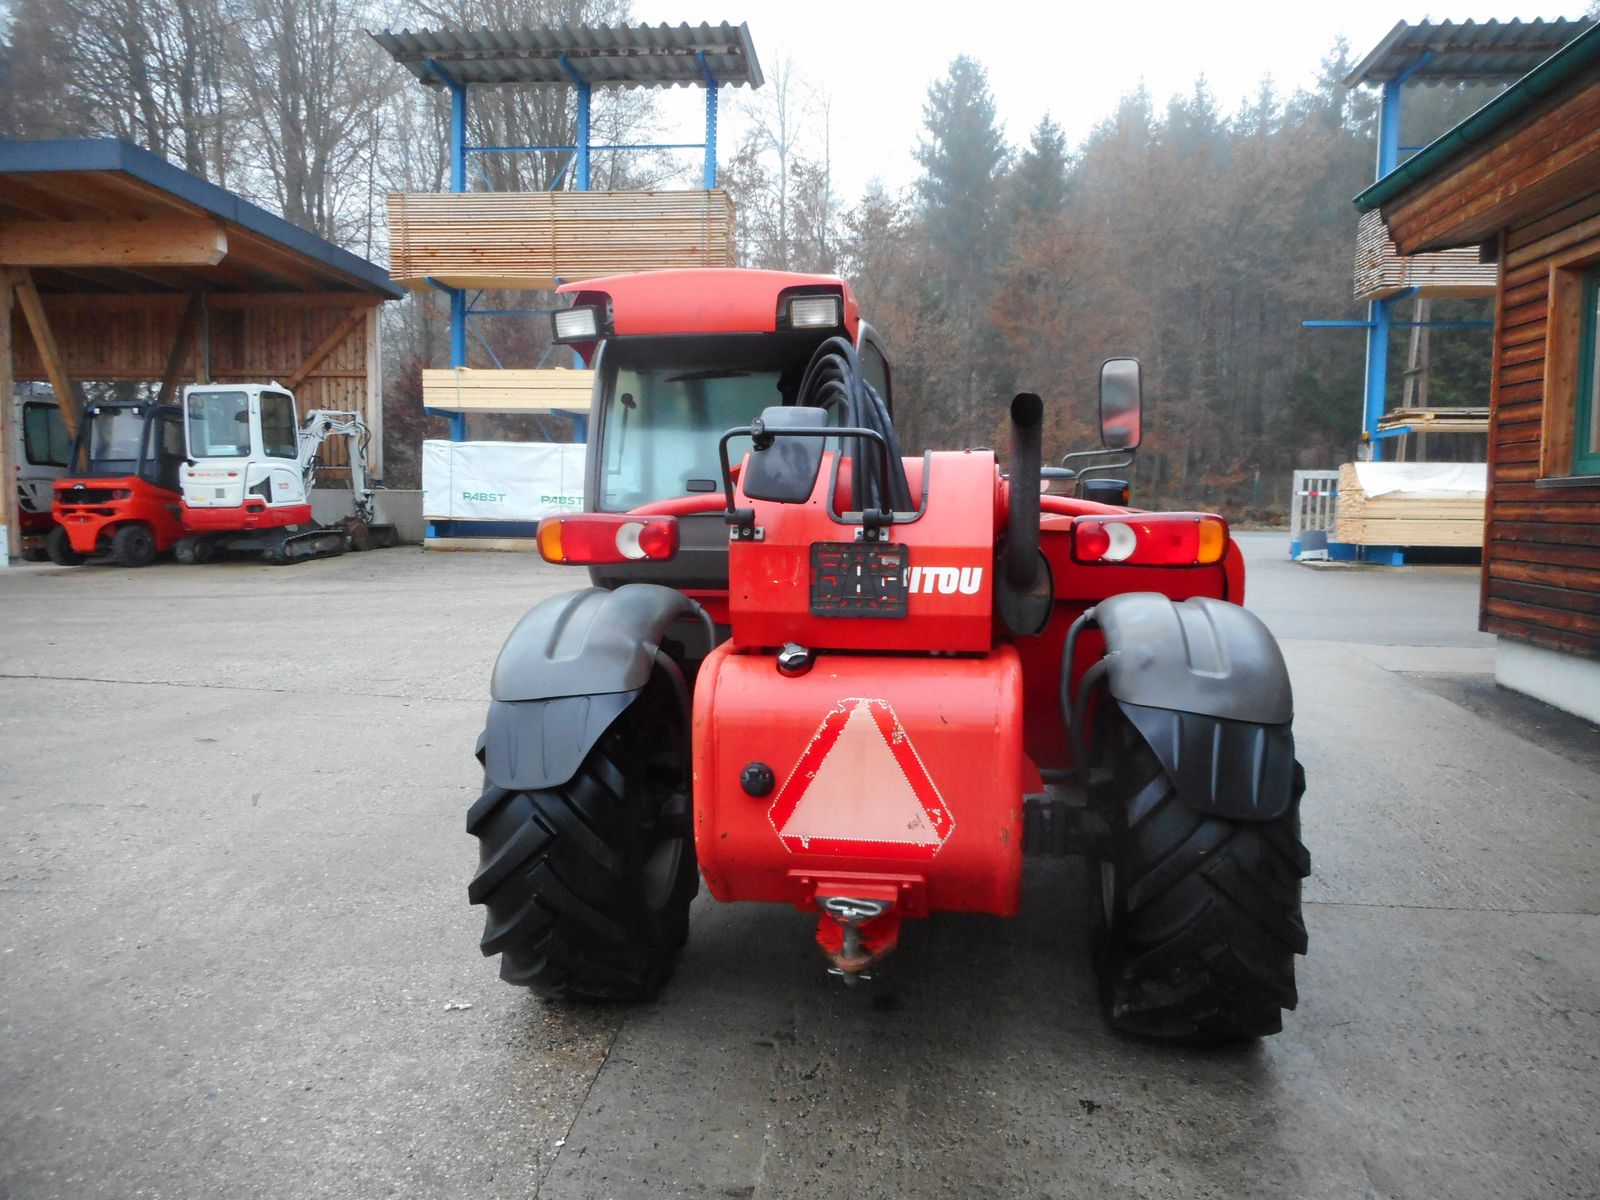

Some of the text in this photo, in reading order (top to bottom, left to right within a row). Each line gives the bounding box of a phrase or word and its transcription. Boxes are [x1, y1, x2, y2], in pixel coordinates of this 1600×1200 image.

[463, 491, 506, 502] PABST
[541, 495, 584, 505] PABST
[908, 566, 983, 594] ITOU
